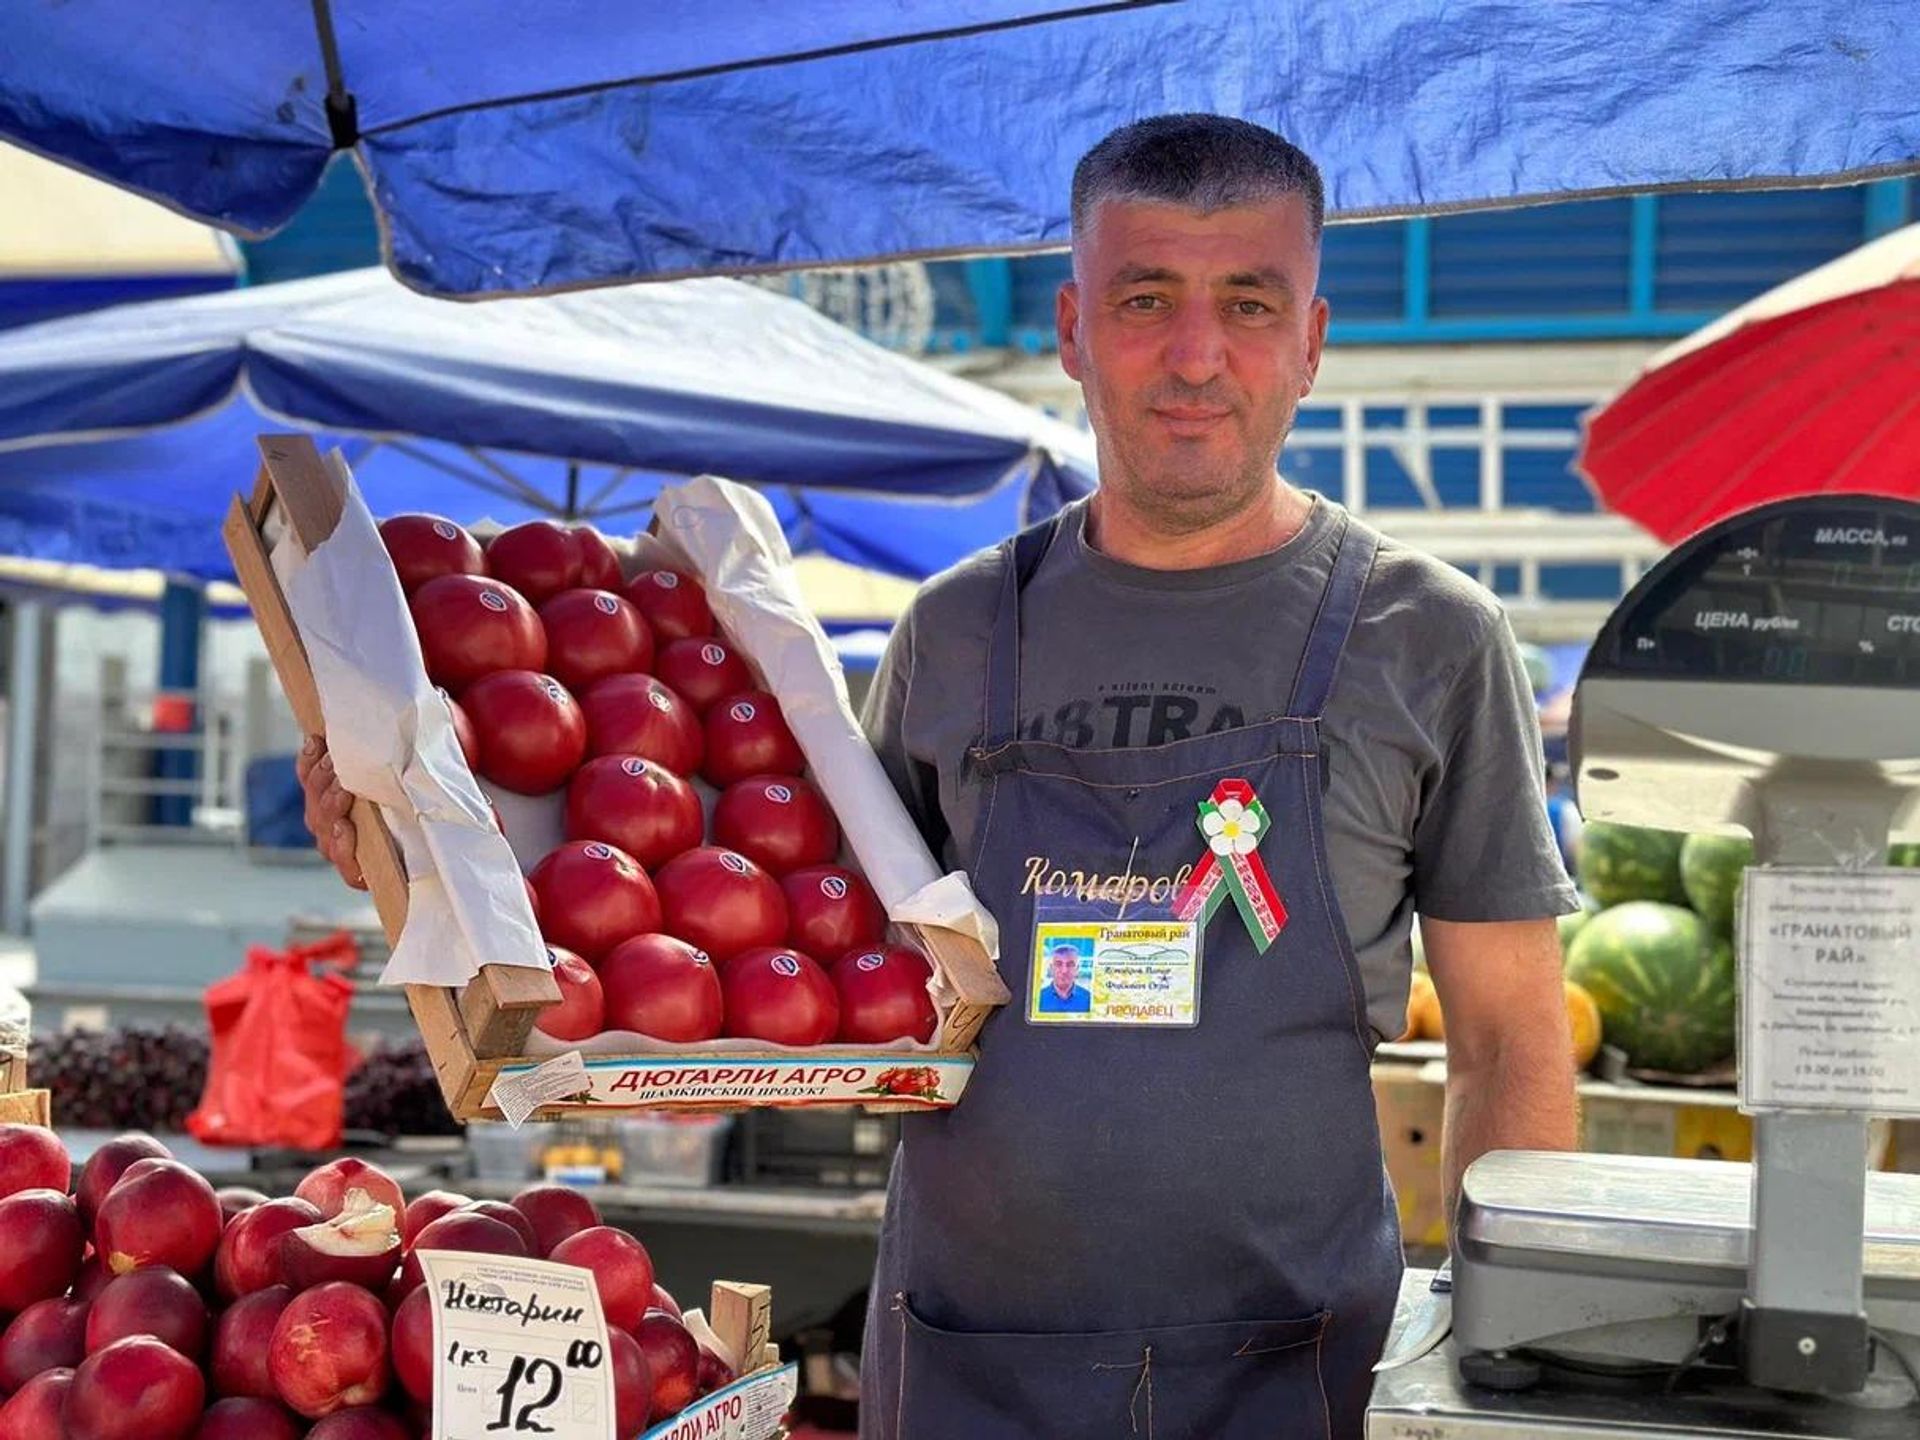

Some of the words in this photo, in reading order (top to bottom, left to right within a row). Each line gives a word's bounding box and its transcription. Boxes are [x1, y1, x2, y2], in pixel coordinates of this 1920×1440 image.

[1695, 612, 1749, 631] ЦЕНА
[610, 1068, 780, 1092] ДЮГАРЛИ
[783, 1067, 867, 1085] АГРО
[639, 1087, 753, 1101] ШАМКИРСКИЙ
[754, 1086, 829, 1097] ПРОДУКТ
[443, 1280, 584, 1327] Нектарин
[486, 1355, 563, 1433] 12
[565, 1339, 601, 1368] 00
[705, 1396, 743, 1436] АГРО
